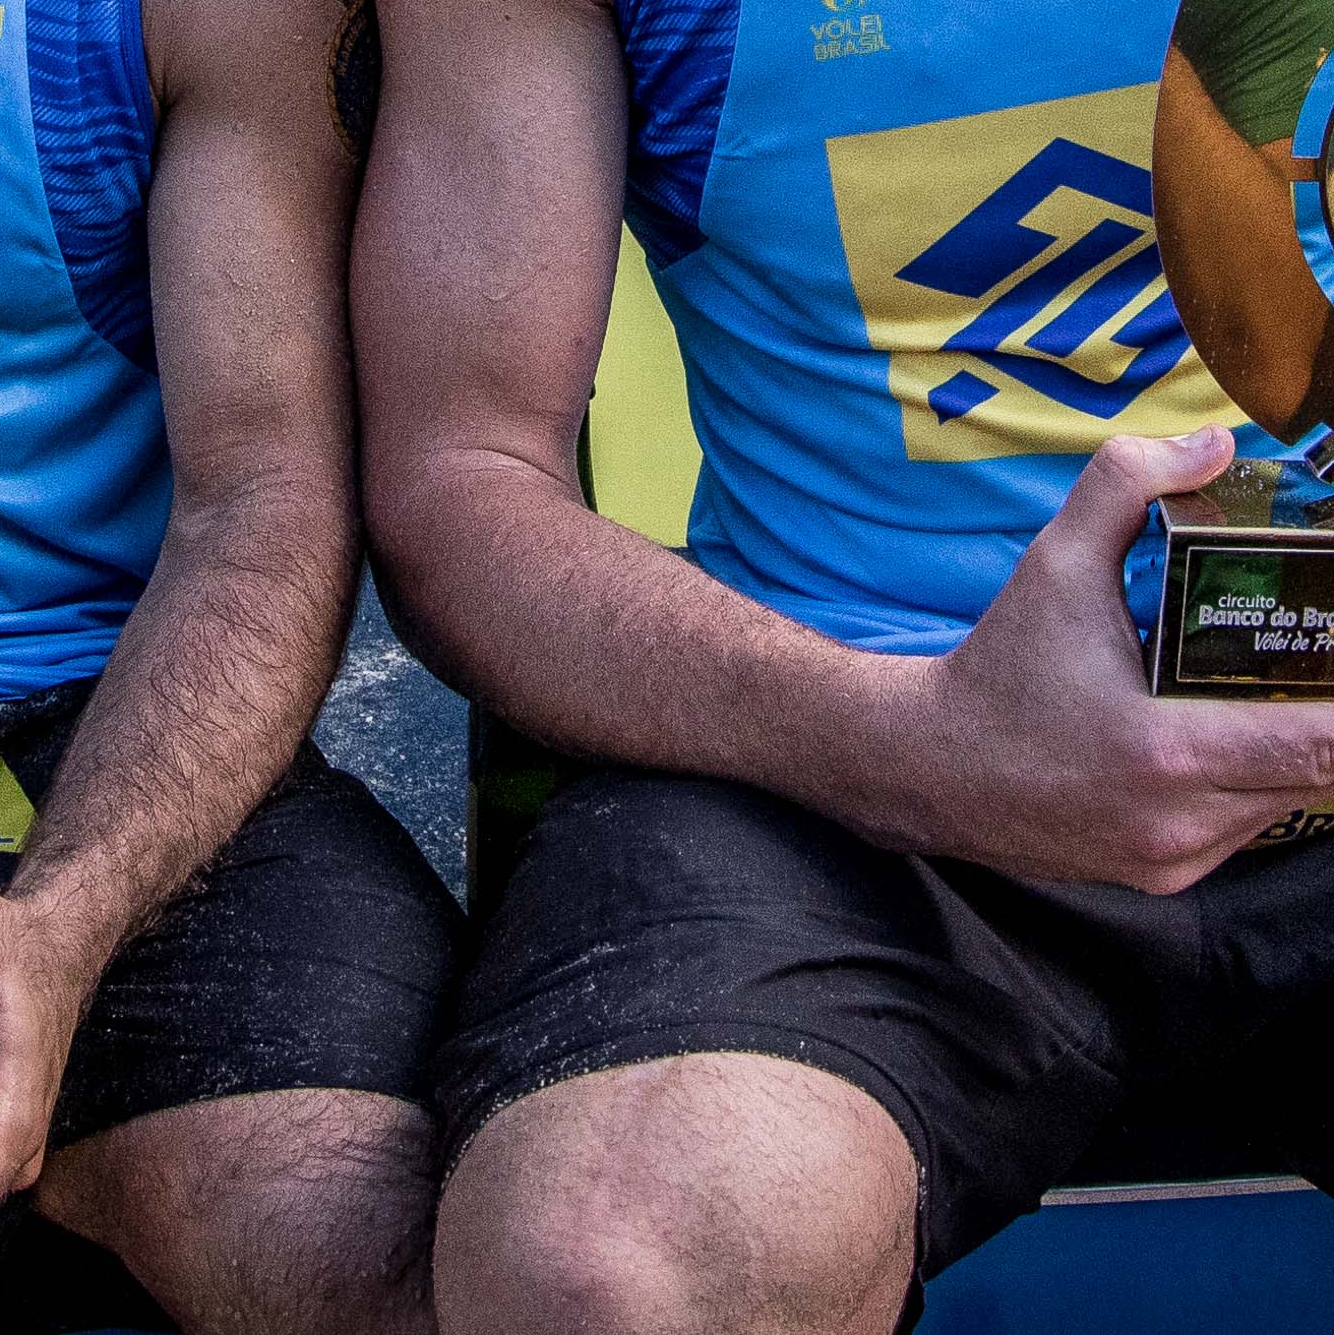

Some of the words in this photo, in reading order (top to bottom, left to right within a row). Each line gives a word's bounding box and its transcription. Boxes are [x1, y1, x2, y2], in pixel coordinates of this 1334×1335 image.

[1218, 593, 1276, 609] circuito
[1198, 605, 1265, 626] Banco
[1270, 605, 1297, 628] do
[1253, 630, 1291, 651] Vôlei
[1291, 630, 1309, 651] de
